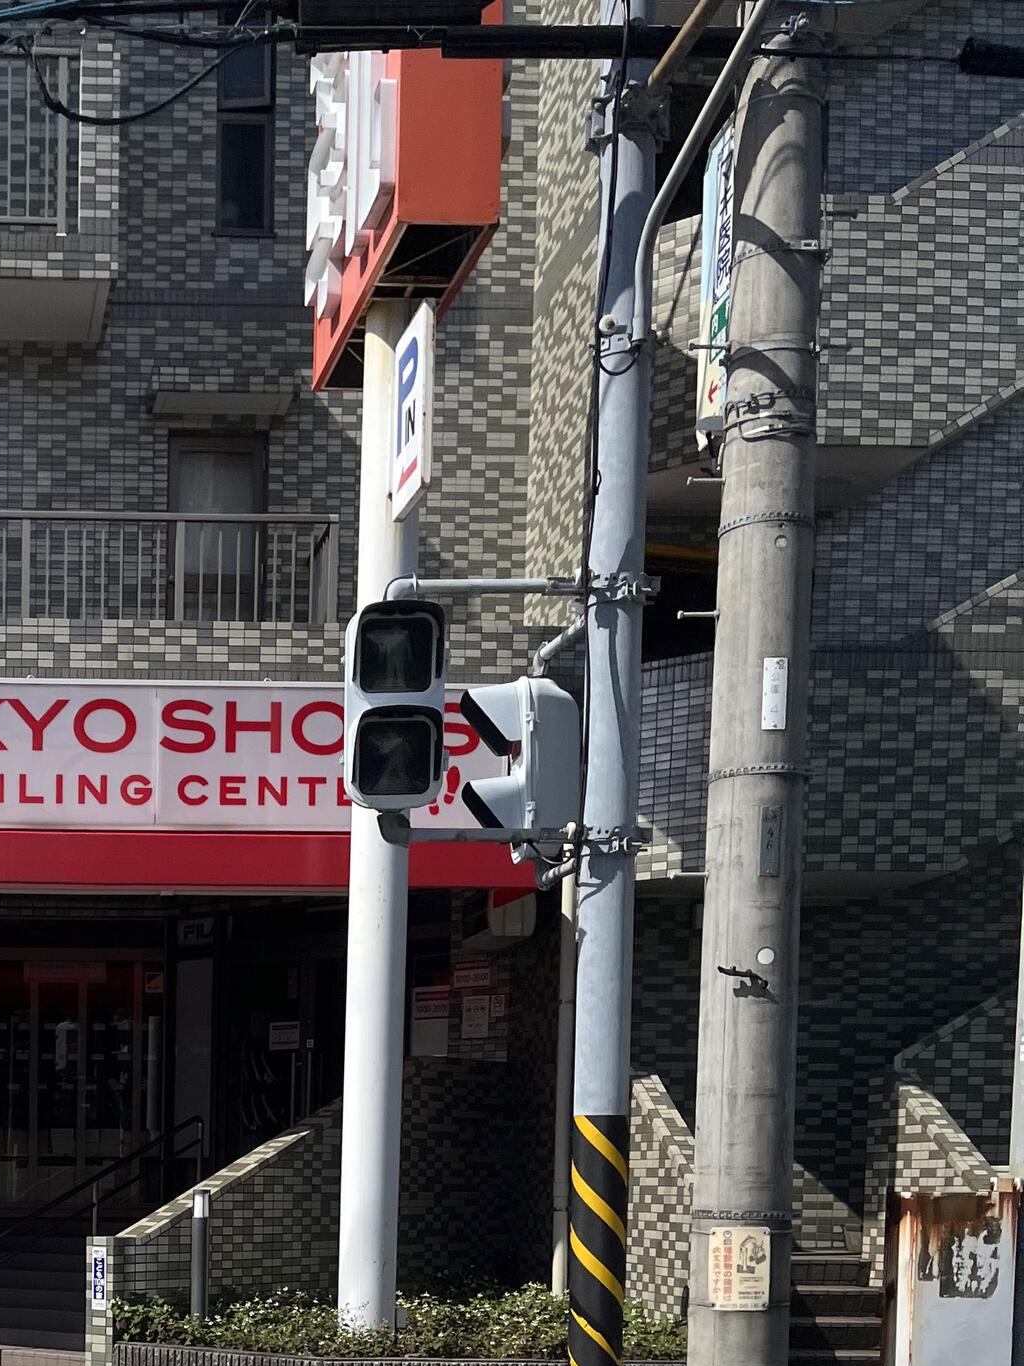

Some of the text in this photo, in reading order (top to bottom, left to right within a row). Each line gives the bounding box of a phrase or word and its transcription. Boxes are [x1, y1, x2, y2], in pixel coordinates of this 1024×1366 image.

[397, 336, 419, 459] P
[405, 399, 416, 446] IN
[161, 701, 480, 757] SHOS
